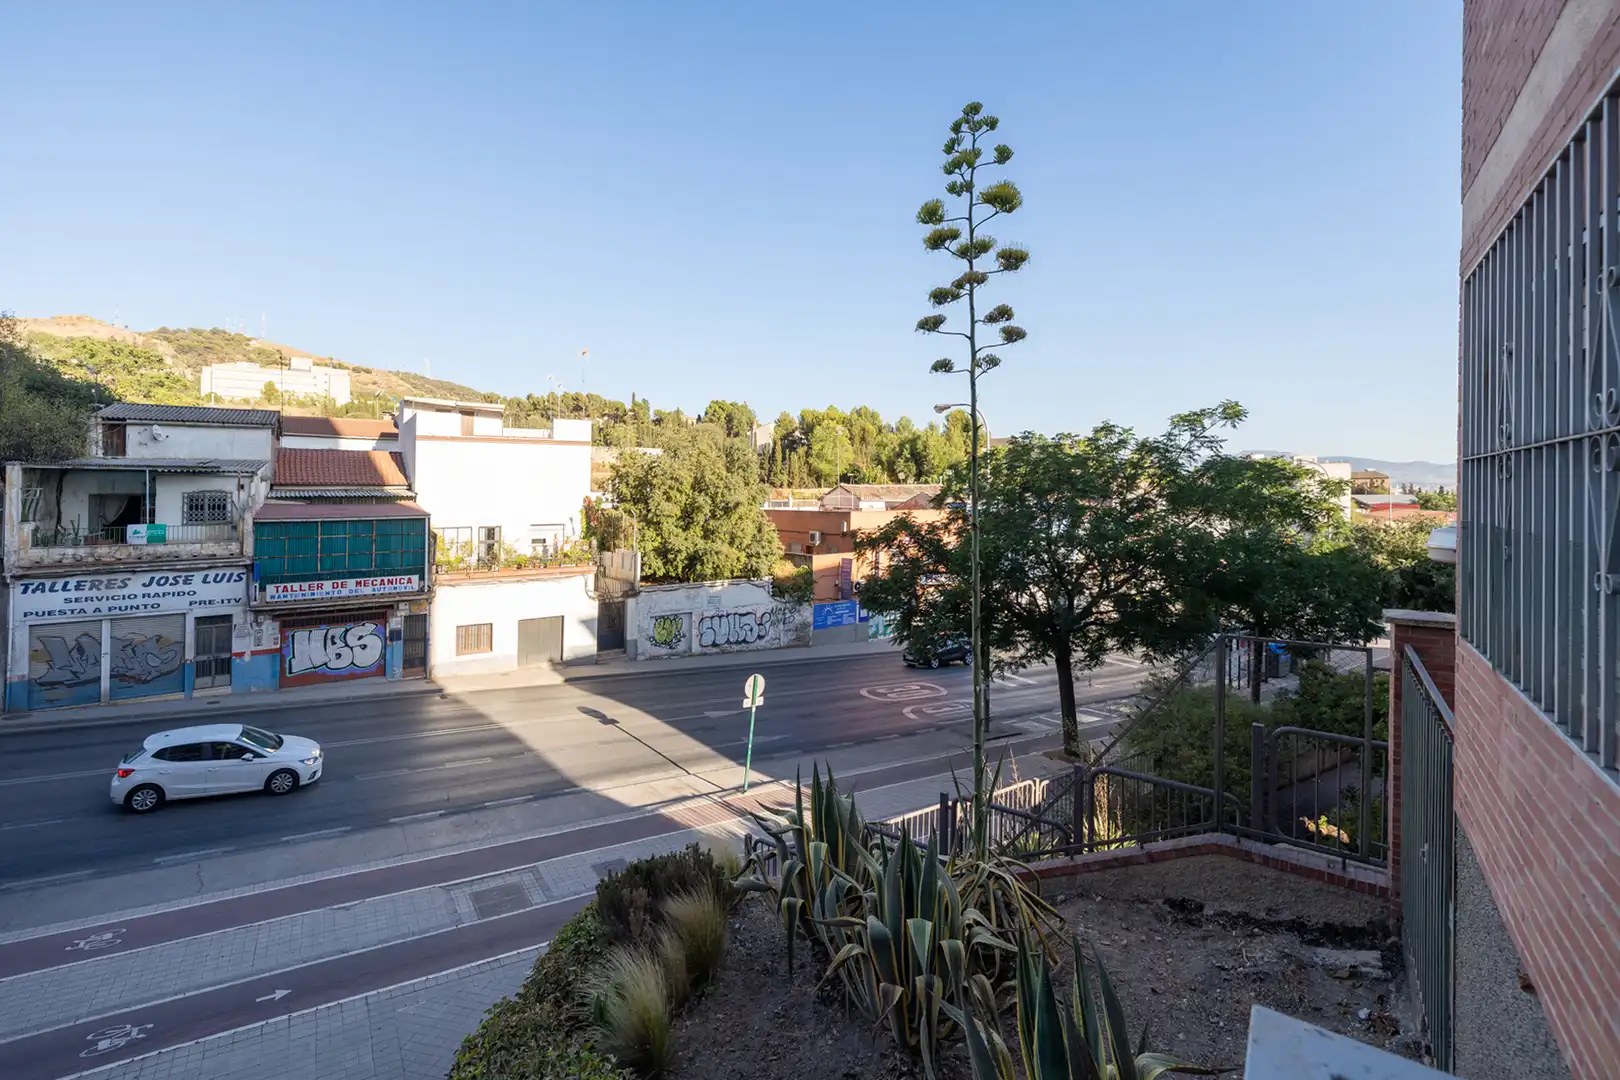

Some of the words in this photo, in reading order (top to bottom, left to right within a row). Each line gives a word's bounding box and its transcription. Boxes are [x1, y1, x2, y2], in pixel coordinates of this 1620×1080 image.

[20, 577, 131, 595] TALLERES
[141, 573, 195, 589] JOSE
[201, 571, 247, 584] LUIS
[274, 583, 324, 593] TALLER
[332, 580, 348, 590] DE
[355, 577, 413, 588] MECANICA
[63, 593, 138, 604] SERVICIO
[142, 589, 197, 600] RAPIDO
[270, 589, 342, 600] MANTENIMIENTO
[371, 585, 415, 593] AUTOMOVIL
[23, 607, 87, 618] PUESTA
[107, 602, 161, 613] PUNTO
[188, 597, 242, 607] PRE-ITV
